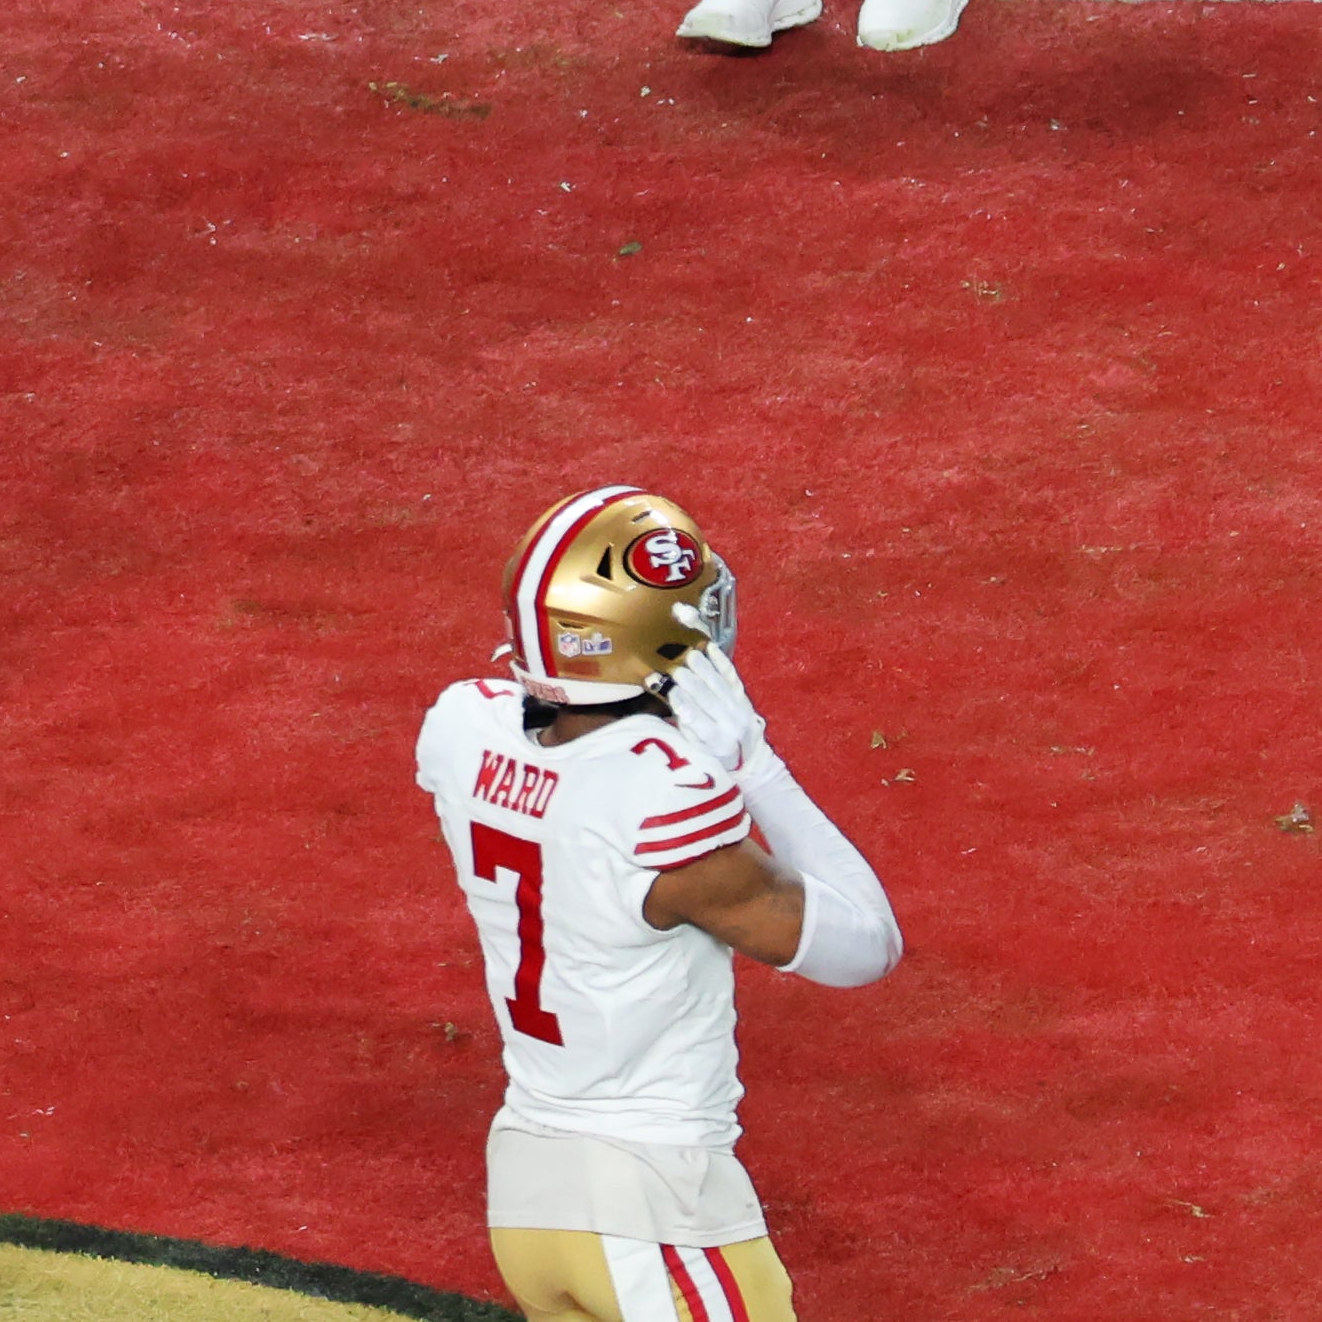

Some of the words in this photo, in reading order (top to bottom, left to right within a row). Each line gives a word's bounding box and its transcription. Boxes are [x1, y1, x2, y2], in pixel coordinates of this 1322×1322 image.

[645, 530, 696, 582] SF
[473, 749, 559, 819] WARD
[631, 738, 691, 771] 7
[470, 820, 565, 1048] 7
